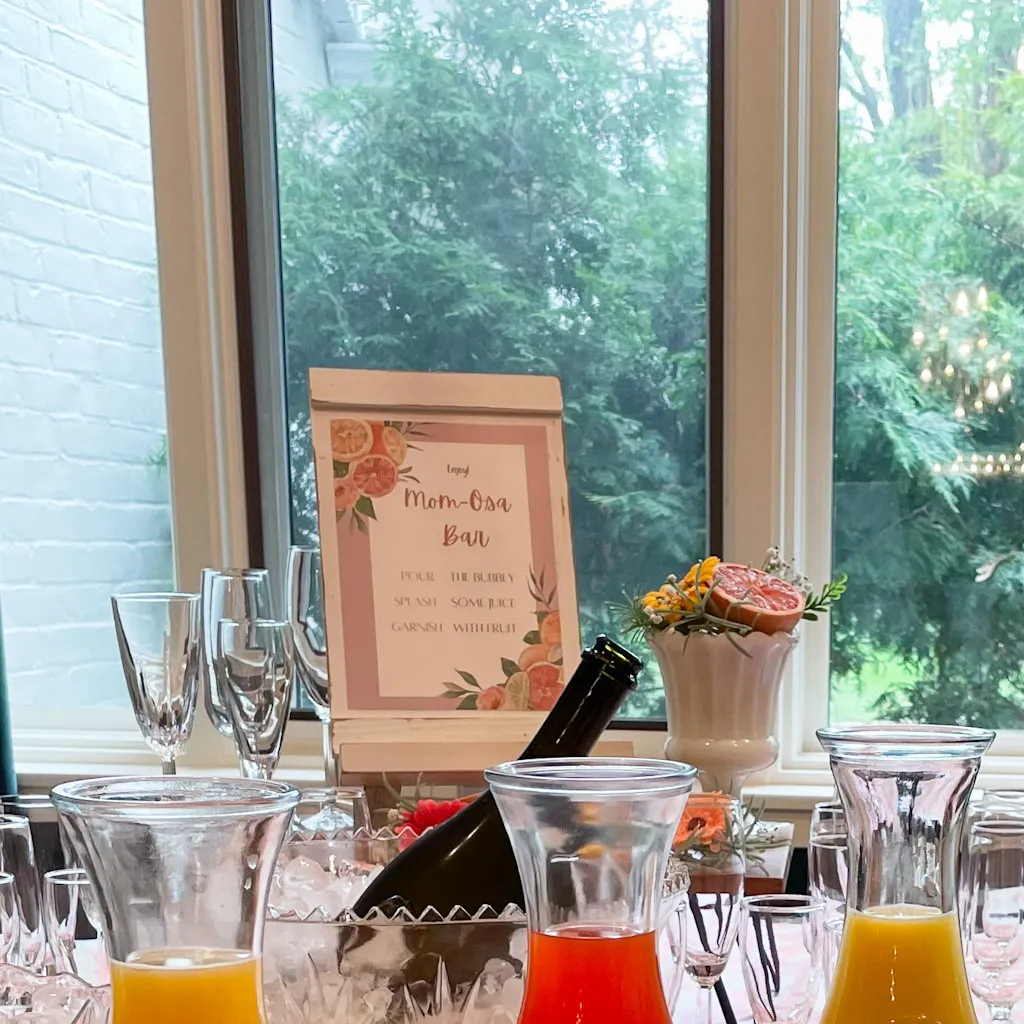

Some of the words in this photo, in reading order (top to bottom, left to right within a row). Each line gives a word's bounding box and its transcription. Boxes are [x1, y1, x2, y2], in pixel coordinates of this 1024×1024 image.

[404, 488, 512, 512] Mom-Osa
[442, 524, 490, 548] Bar
[401, 571, 435, 582] POUR
[451, 572, 470, 582] THE
[473, 572, 515, 583] BUBBLY
[394, 597, 437, 607] SPLASH
[451, 597, 484, 608] SOME
[488, 598, 515, 609] JUICE
[391, 621, 443, 632] GARNISH
[453, 623, 484, 633] WITH
[486, 623, 516, 633] FRUIT
